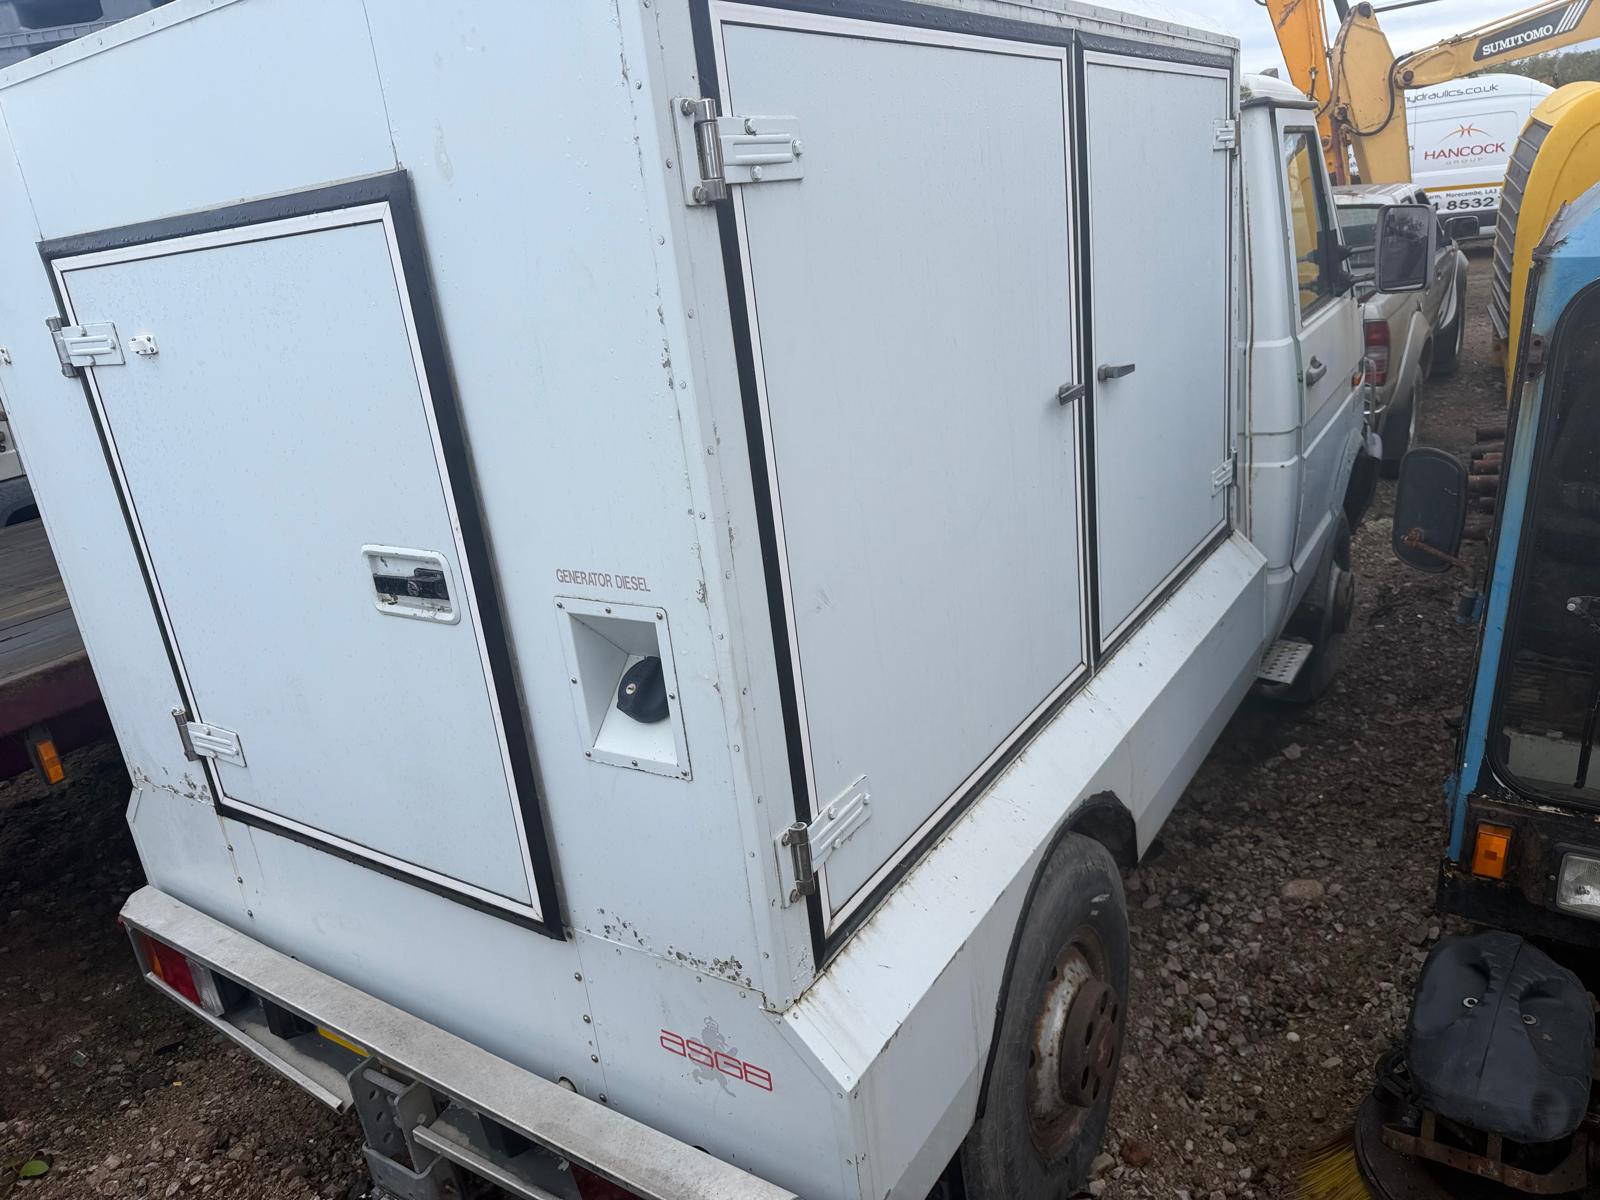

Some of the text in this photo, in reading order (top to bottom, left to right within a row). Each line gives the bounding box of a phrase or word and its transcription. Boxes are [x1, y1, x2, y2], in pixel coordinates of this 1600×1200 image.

[1482, 24, 1553, 56] SUMITOMO
[1424, 142, 1505, 160] HANCOCK
[1446, 197, 1495, 211] 8532
[555, 568, 651, 593] GENERATOR DIESEL
